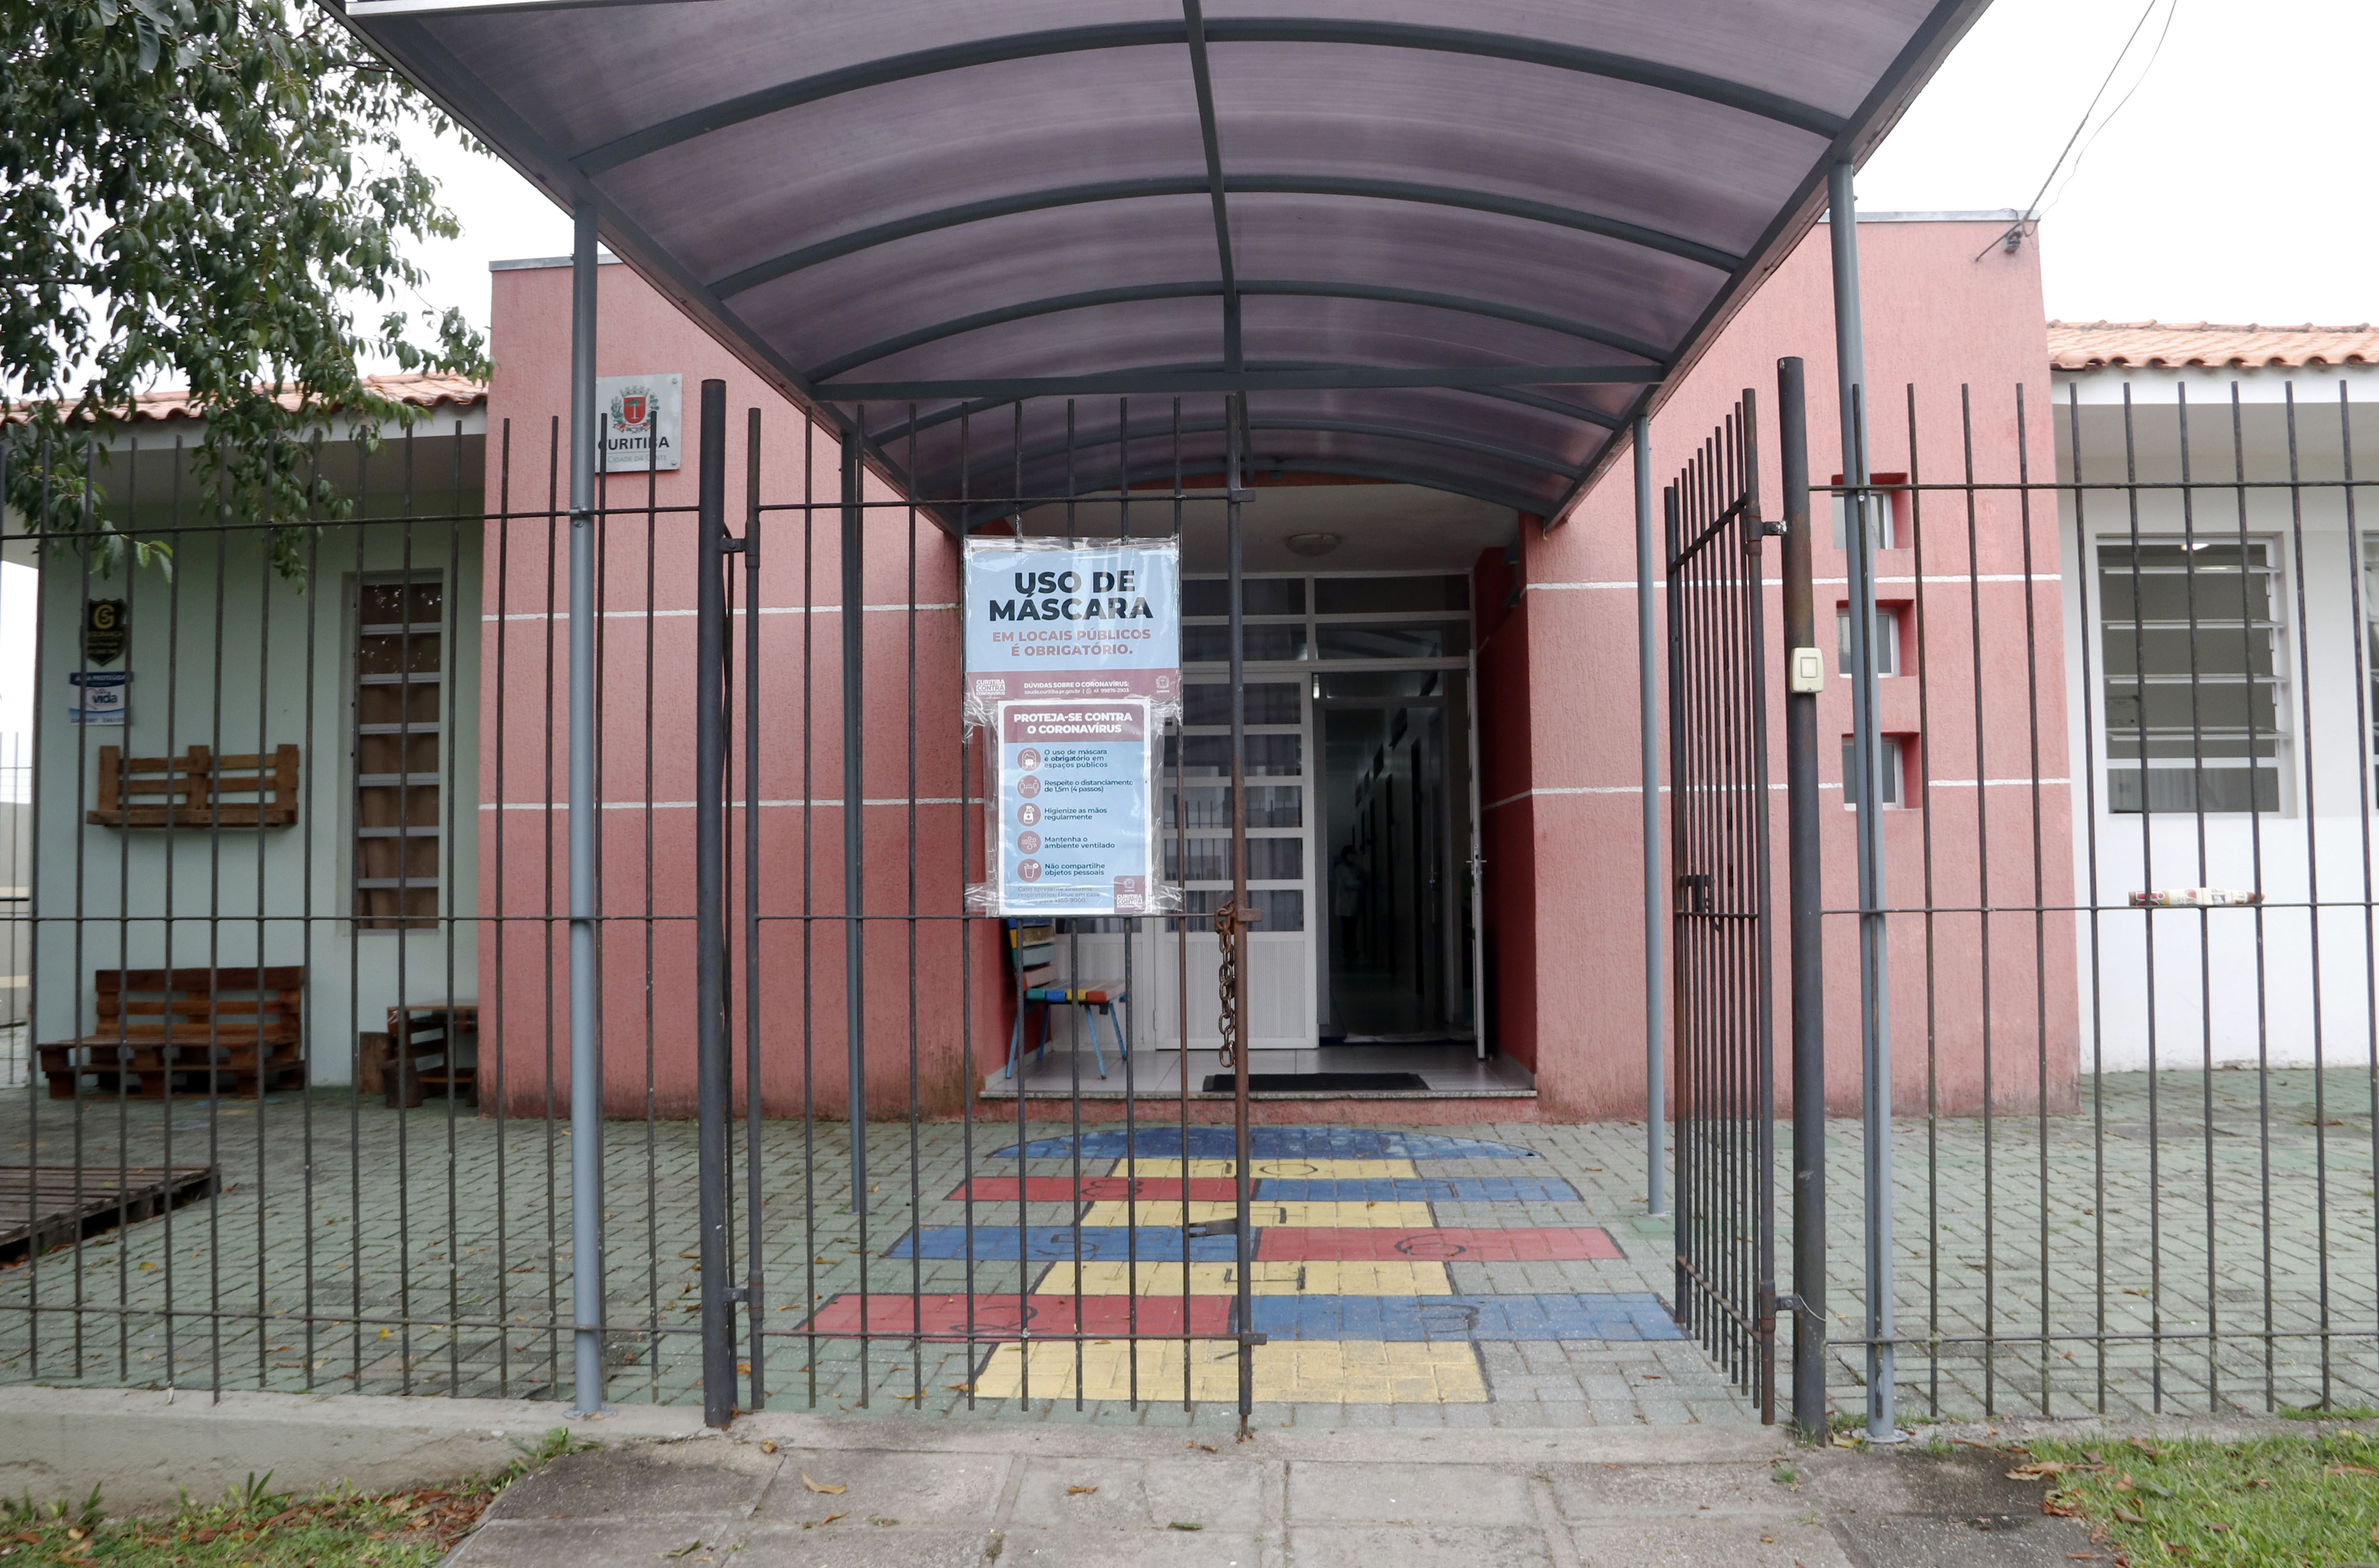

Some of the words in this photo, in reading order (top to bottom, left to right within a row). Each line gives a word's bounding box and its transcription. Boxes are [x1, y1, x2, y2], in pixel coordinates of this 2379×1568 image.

[1015, 571, 1082, 594] USO
[1093, 570, 1135, 593] DE
[989, 593, 1153, 621] MÁSCARA
[992, 631, 1014, 642] EM
[1019, 630, 1072, 642] LOCAIS
[1077, 628, 1151, 641] PÚBLICOS
[1011, 643, 1020, 656] É
[1024, 642, 1133, 656] OBRIGATÓRIO.
[1013, 712, 1082, 723] PROTEJA-SE
[1084, 712, 1133, 722] CONTRA
[1027, 725, 1037, 734] O
[1038, 722, 1122, 734] CORONAVÍRUS
[1076, 761, 1108, 769] públicos
[1044, 780, 1074, 788] Respeite
[1070, 785, 1078, 794] (4
[1078, 785, 1104, 794] passos)
[1044, 807, 1077, 815] Higienize
[1044, 813, 1093, 822] regularmente
[1060, 862, 1106, 871] compartilhe
[1044, 869, 1072, 877] objetos
[1074, 869, 1104, 877] pessoais
